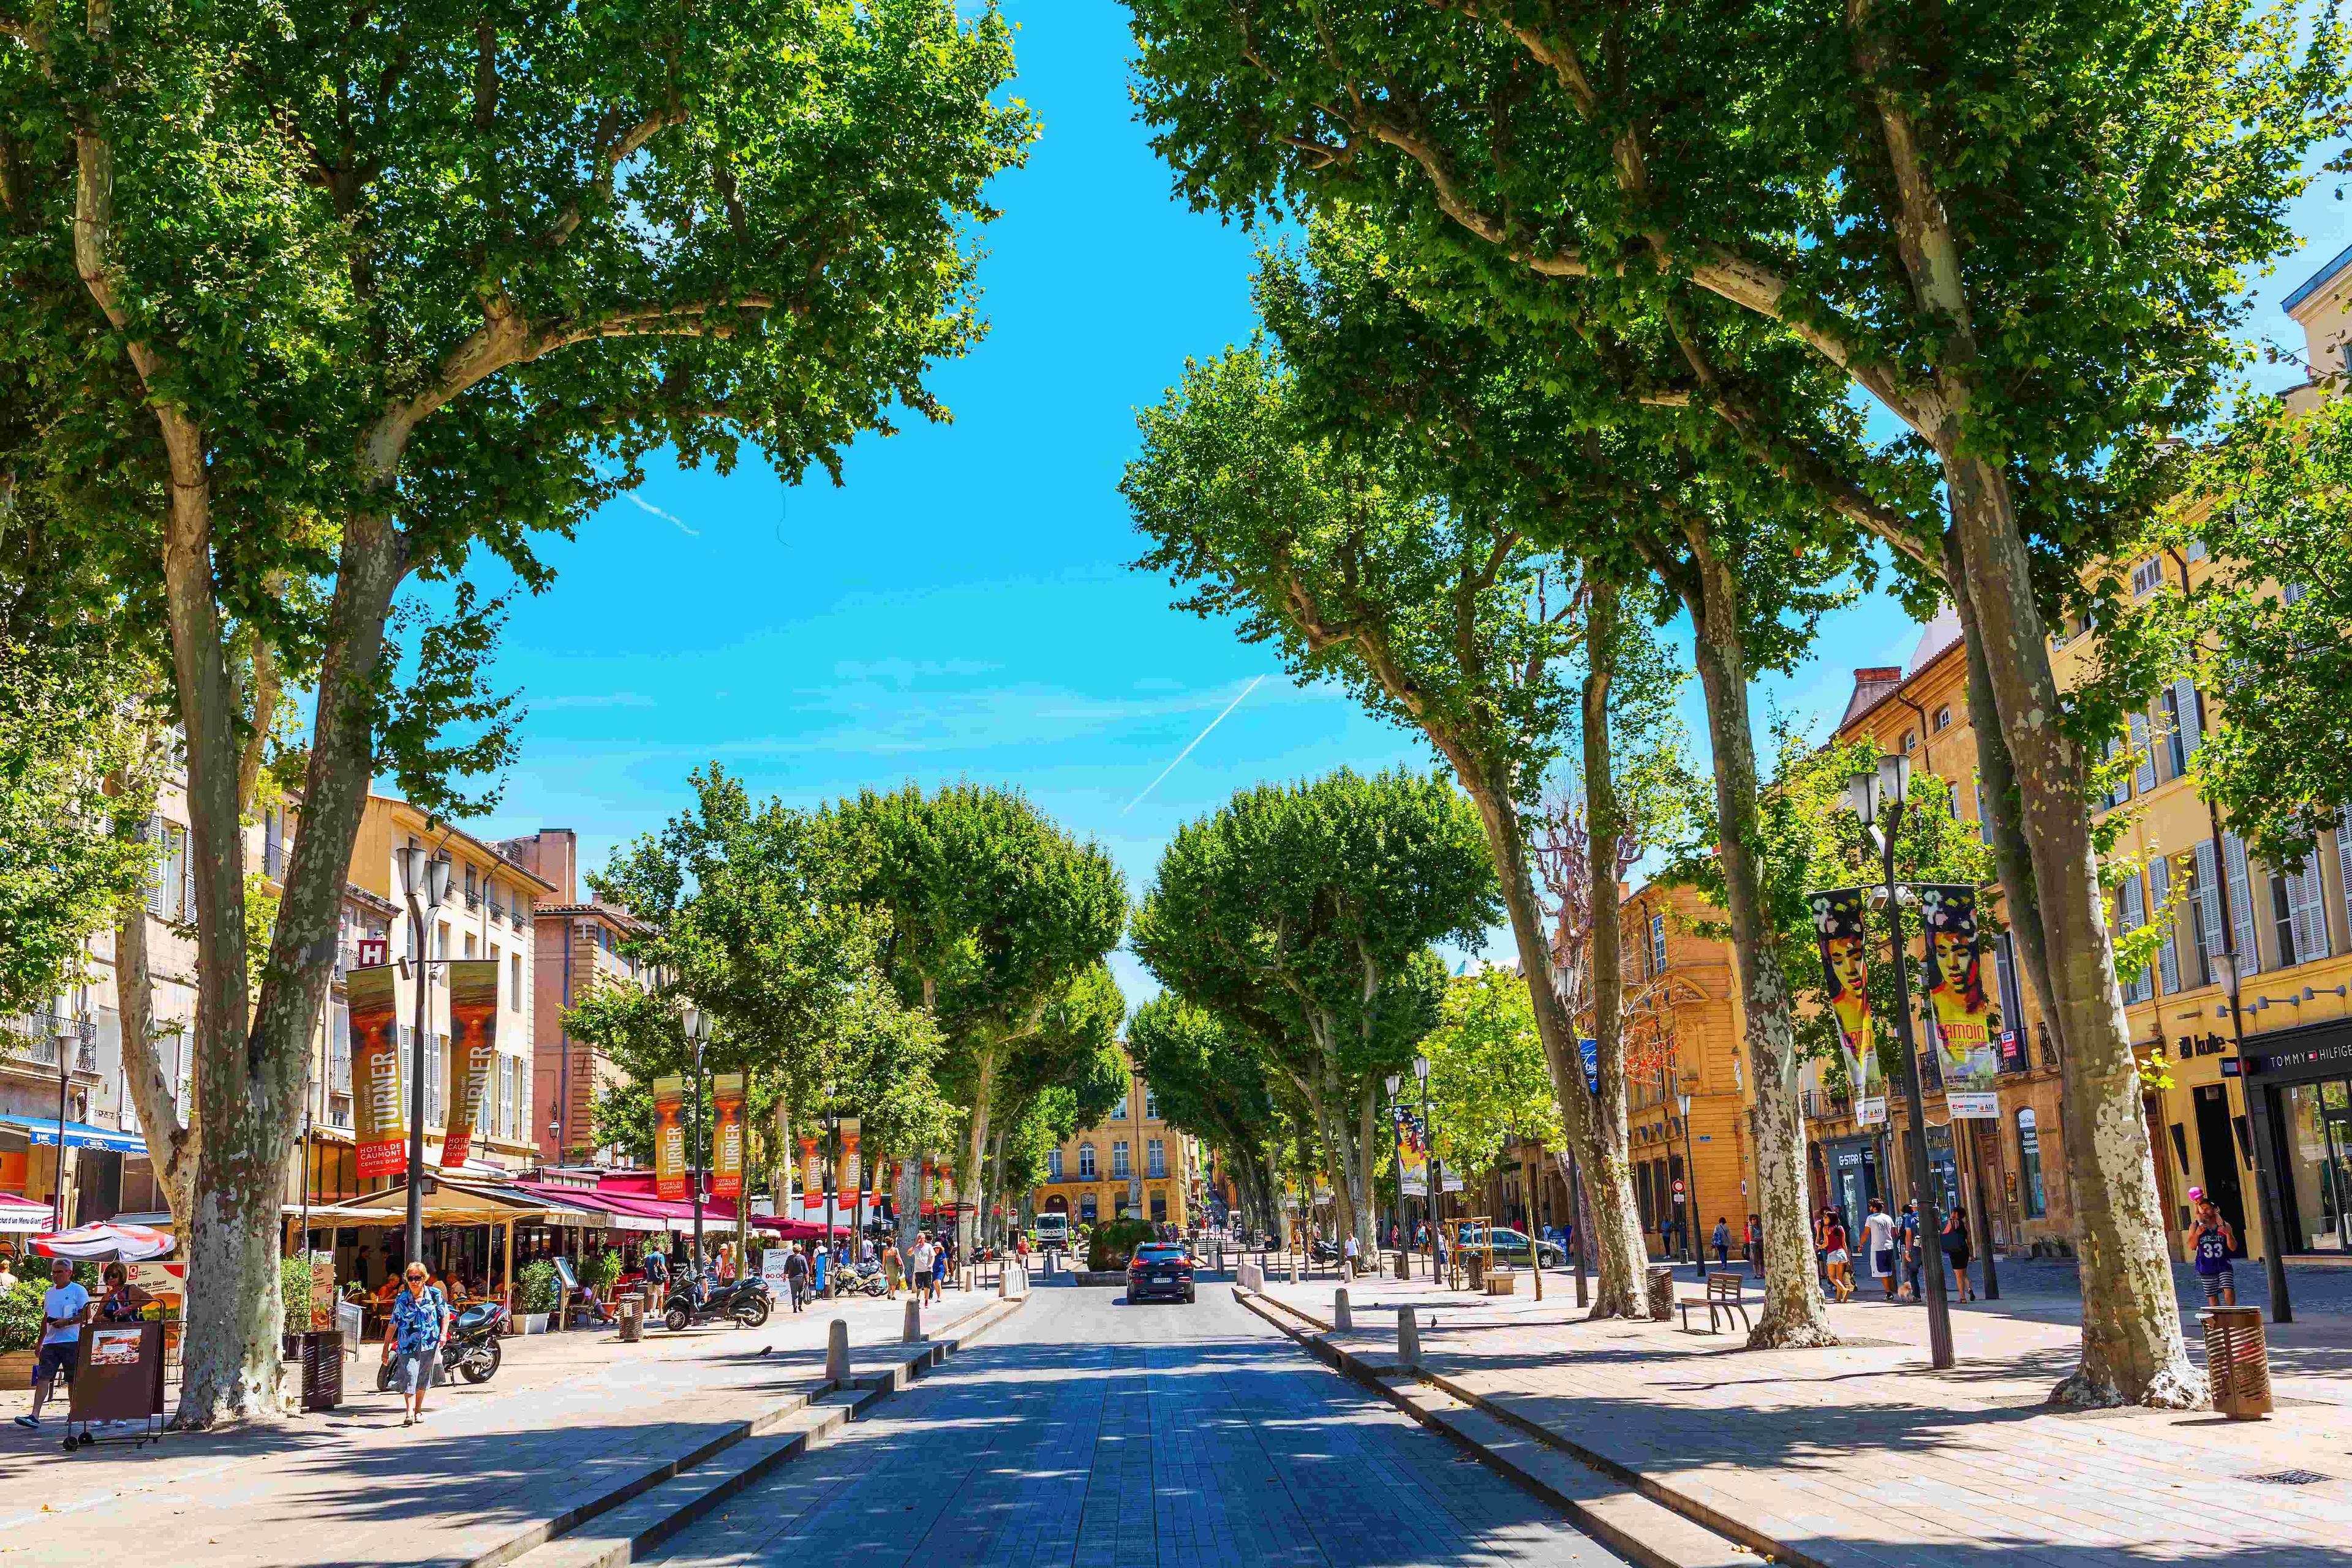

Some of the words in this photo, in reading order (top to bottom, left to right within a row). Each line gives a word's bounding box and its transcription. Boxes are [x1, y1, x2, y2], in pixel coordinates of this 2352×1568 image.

[362, 944, 382, 964] H
[2270, 1052, 2305, 1068] TOMMY
[2318, 1044, 2352, 1060] HILFIGE
[370, 1049, 400, 1133] TURNER
[360, 1145, 388, 1154] HOTEL
[360, 1150, 401, 1160] CAUMONT
[666, 1126, 683, 1176] TURNER
[724, 1123, 740, 1172] TURNER
[1839, 1153, 1859, 1166] G-STAR
[809, 1156, 821, 1191] TURNER
[848, 1153, 860, 1188] TURNER
[925, 1175, 934, 1200] TURNER
[2203, 1243, 2223, 1258] 33
